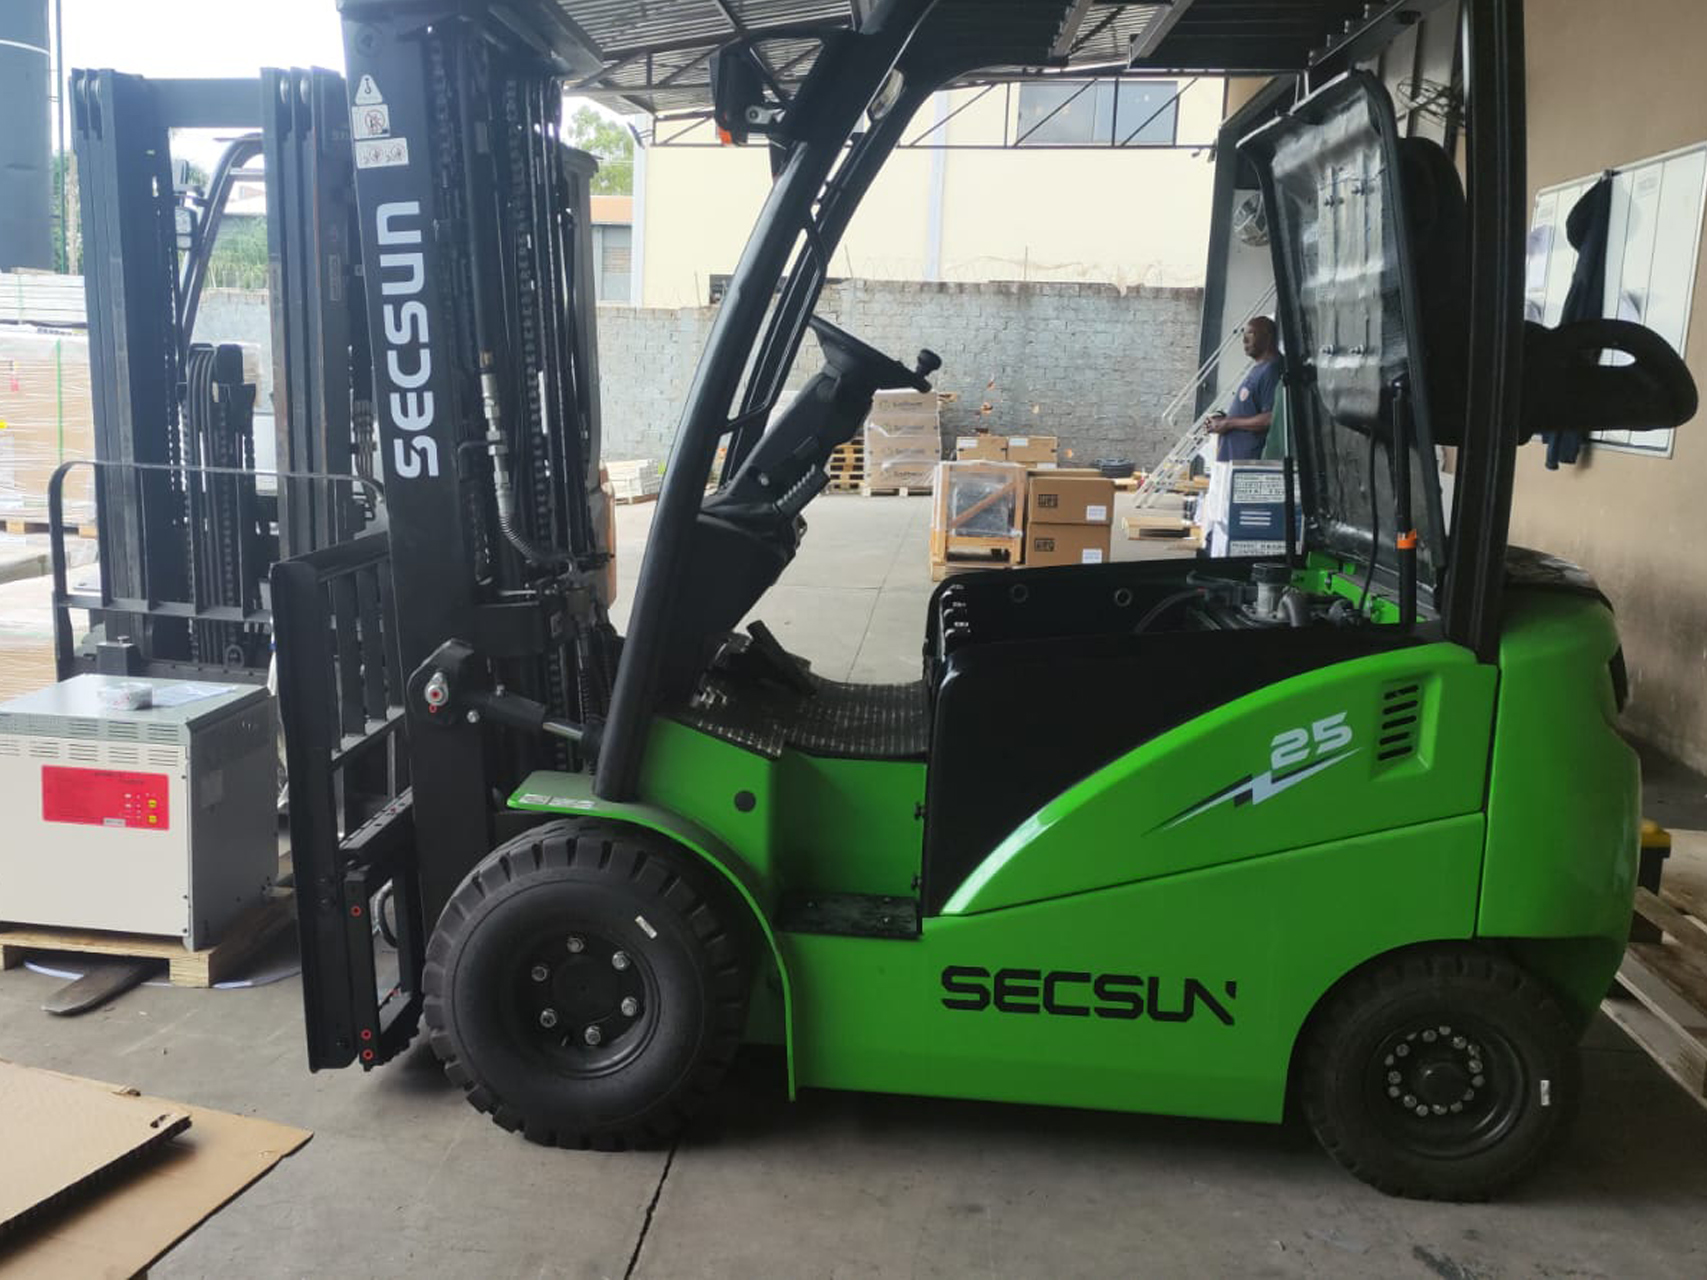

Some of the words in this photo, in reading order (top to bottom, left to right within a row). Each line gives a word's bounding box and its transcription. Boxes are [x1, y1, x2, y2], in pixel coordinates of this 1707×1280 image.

[376, 201, 439, 478] SECSUN
[1270, 711, 1353, 770] 25
[941, 965, 1237, 1026] SECSUN
